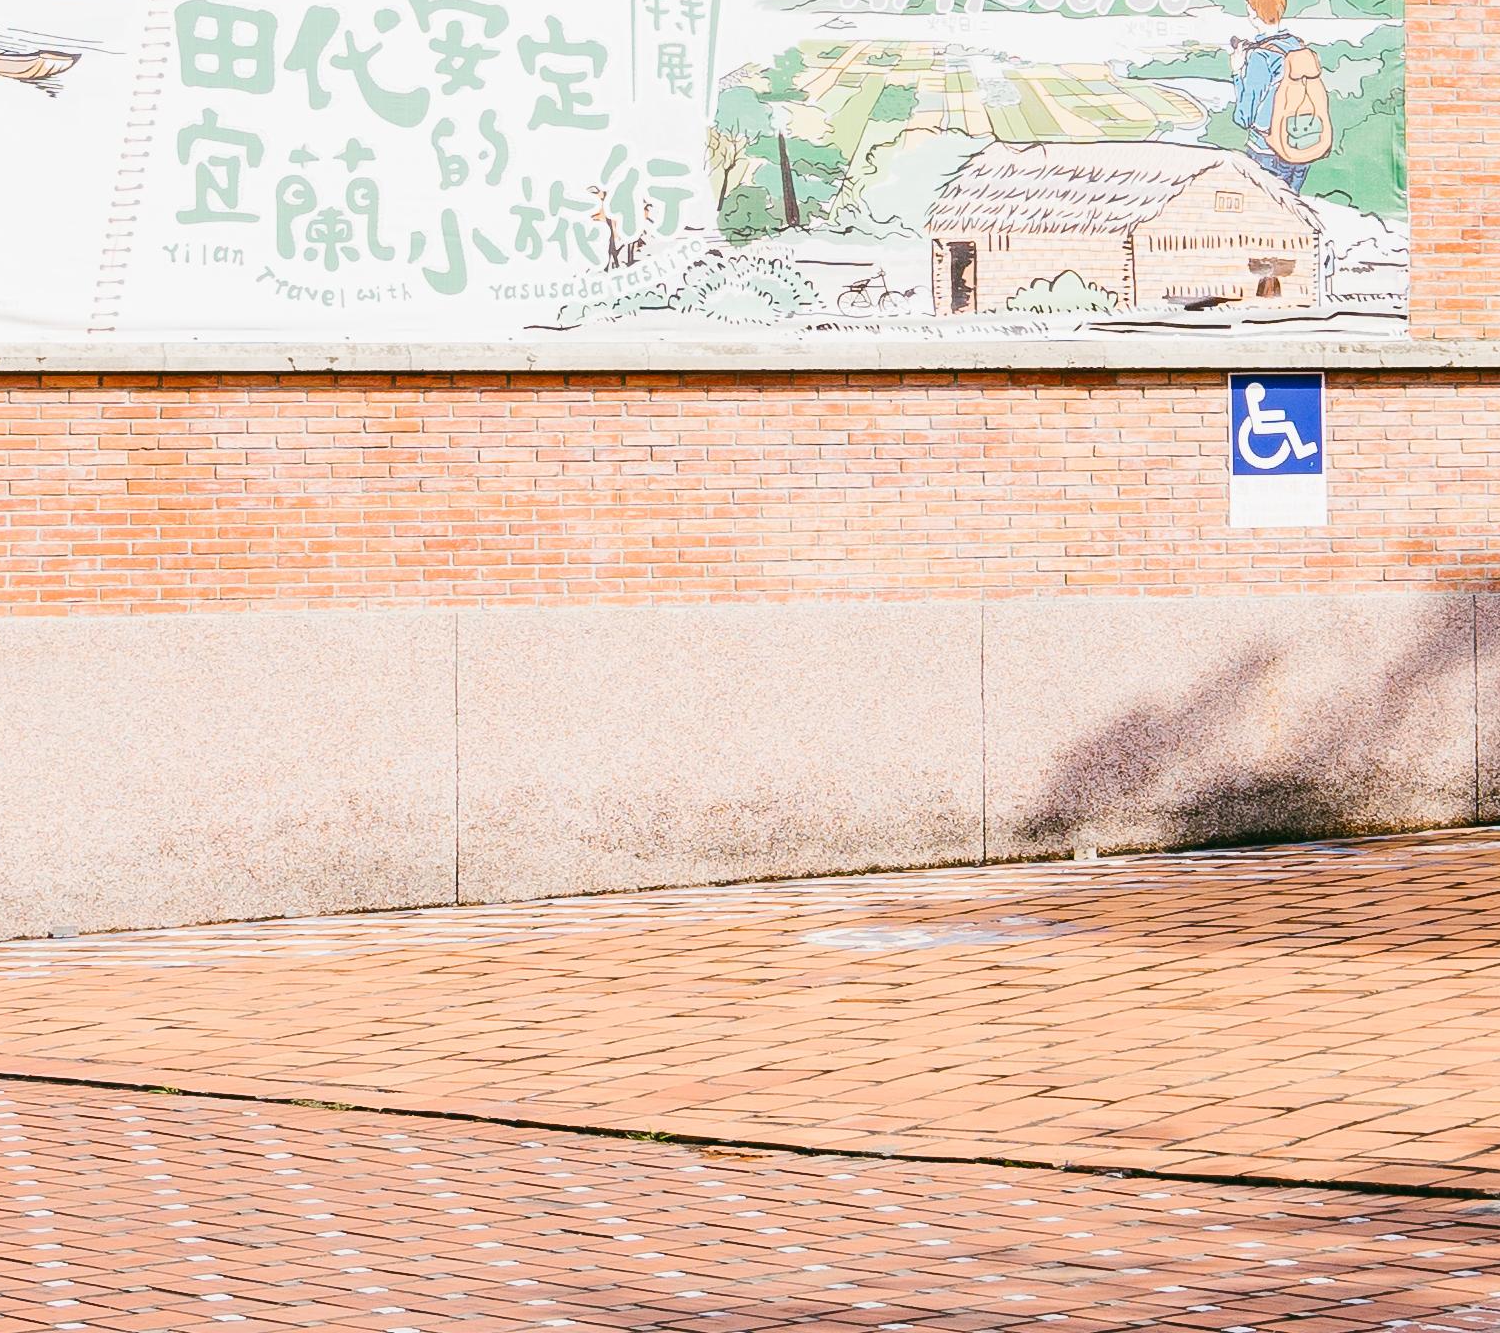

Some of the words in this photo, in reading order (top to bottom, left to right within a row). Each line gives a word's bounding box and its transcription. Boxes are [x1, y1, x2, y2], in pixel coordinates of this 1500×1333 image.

[175, 109, 694, 295] 宜蘭的小旅行
[162, 242, 244, 266] Yilan
[256, 265, 346, 309] Travel
[356, 283, 412, 303] with
[488, 279, 604, 301] Yasusada
